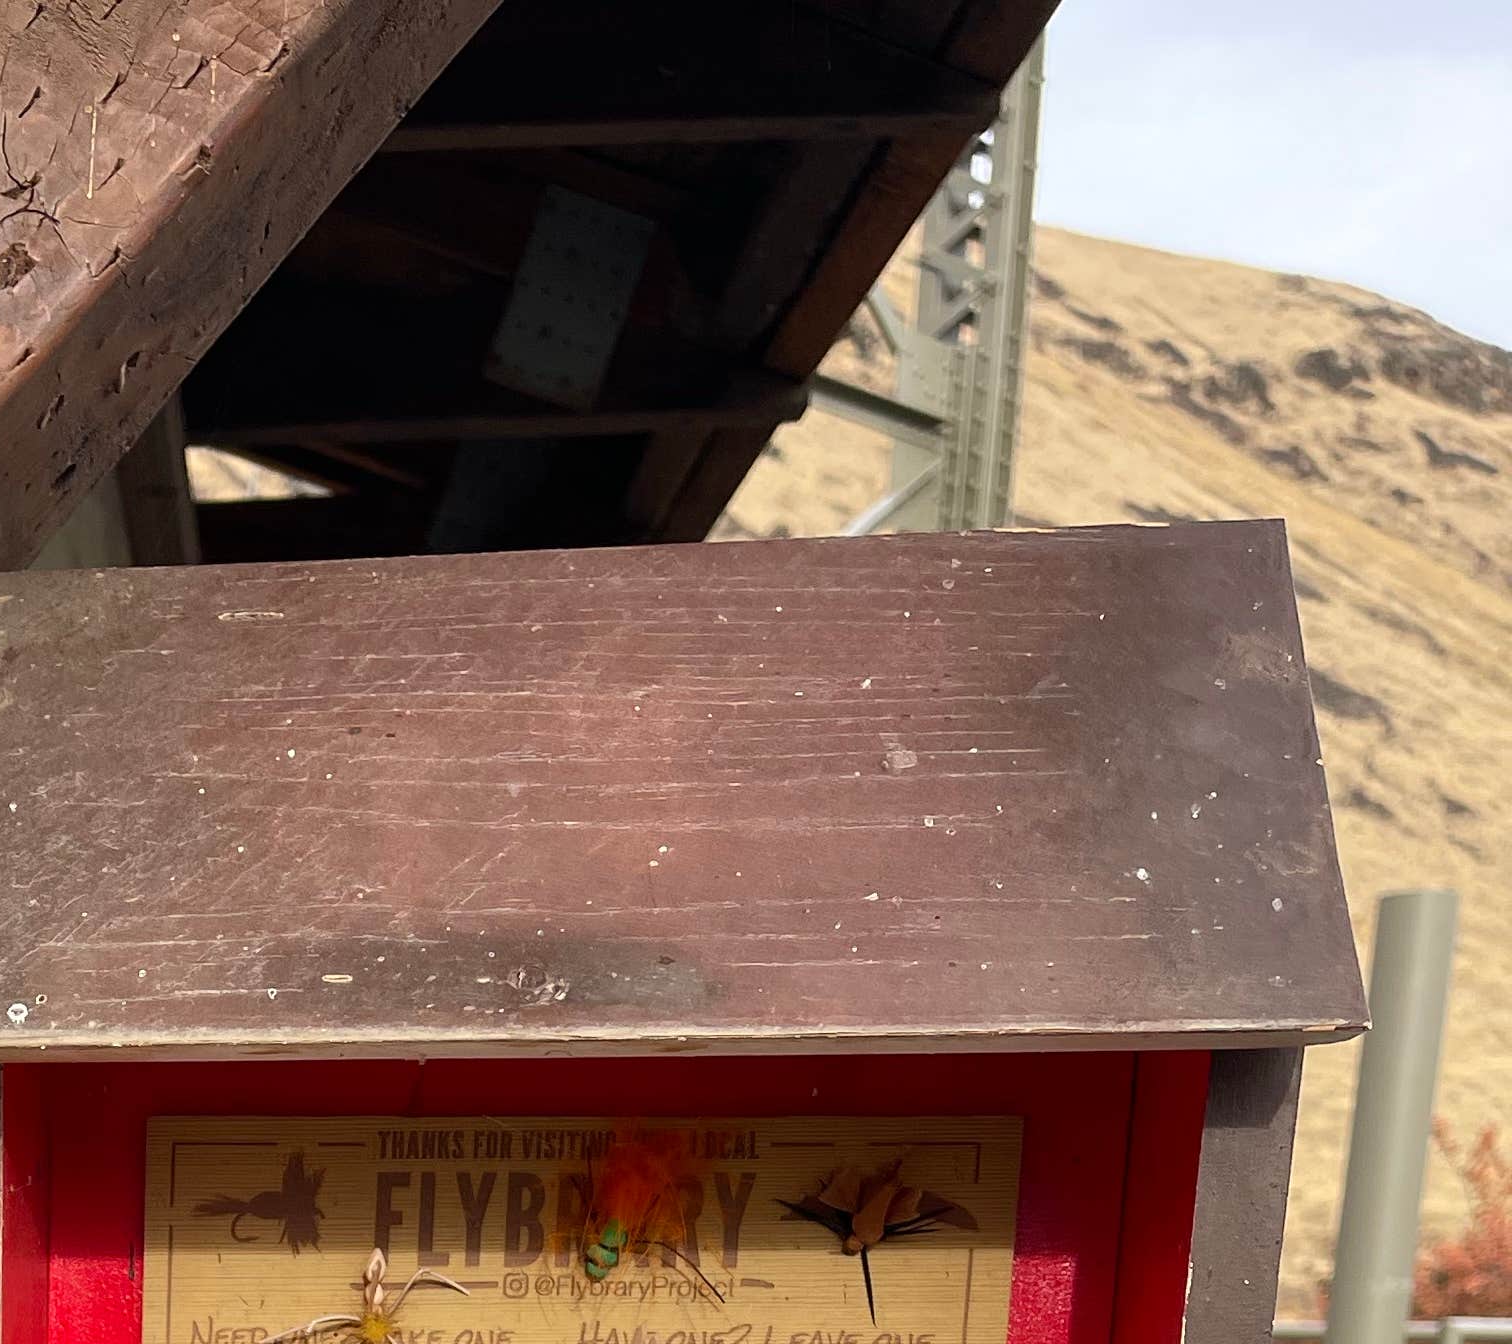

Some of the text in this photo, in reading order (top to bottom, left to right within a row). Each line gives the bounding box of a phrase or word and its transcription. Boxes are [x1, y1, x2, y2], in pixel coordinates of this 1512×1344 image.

[377, 1130, 464, 1160] THANKS
[472, 1130, 513, 1159] FOR
[374, 1171, 757, 1268] FLYBRRY
